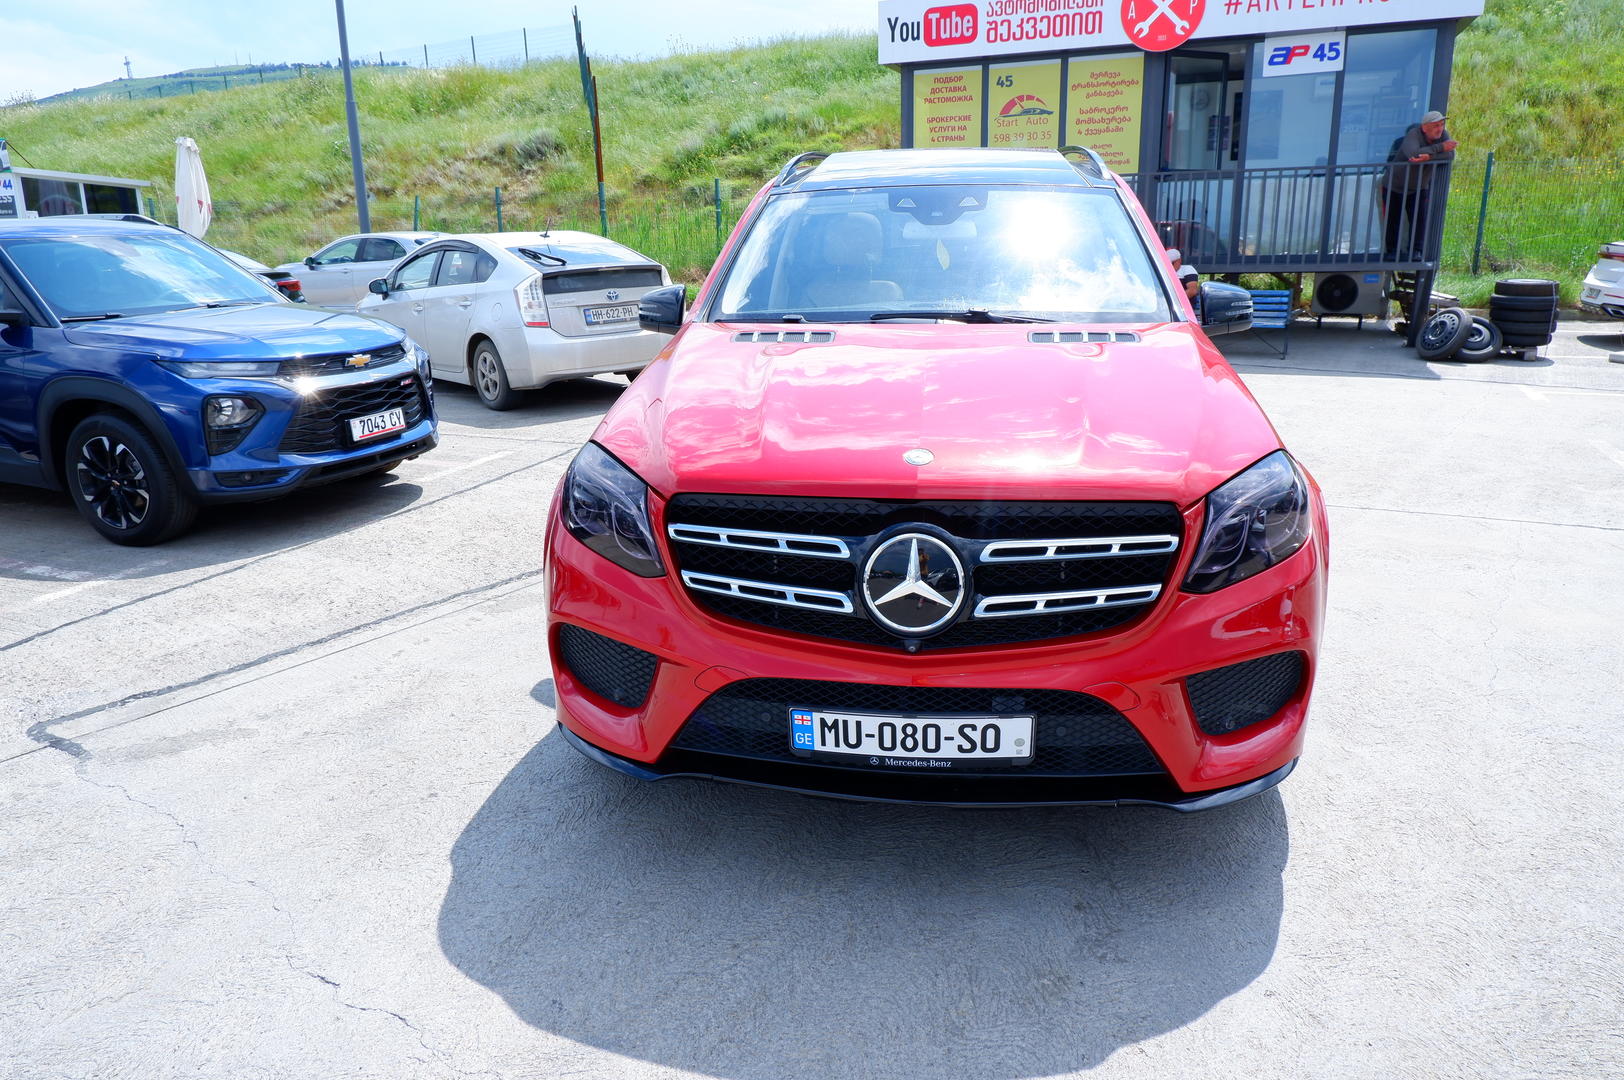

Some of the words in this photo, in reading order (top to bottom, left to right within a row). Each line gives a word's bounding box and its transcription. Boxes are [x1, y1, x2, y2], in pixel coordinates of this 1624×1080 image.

[1128, 0, 1136, 20] A
[1189, 0, 1198, 15] P
[887, 17, 921, 43] You
[928, 12, 974, 40] Tube
[986, 10, 1103, 43] შეკვეთით
[1312, 41, 1341, 62] 45
[933, 75, 964, 84] ПОДБОР
[996, 75, 1014, 88] 45
[930, 85, 967, 95] ДОСТАВКА
[923, 95, 974, 105] РАСТОМОЖКА
[926, 114, 972, 124] БРОКЕРСКИЕ
[996, 118, 1018, 128] Start
[1026, 116, 1049, 126] Auto
[929, 125, 956, 134] УСЛУГИ
[957, 124, 968, 132] НА
[937, 135, 966, 143] СТРАНЫ
[994, 133, 1010, 143] 598
[1027, 131, 1038, 141] 30
[1040, 130, 1052, 140] 35
[591, 308, 634, 321] HH-622-PH
[359, 415, 386, 434] 7043
[389, 411, 402, 427] CY
[795, 732, 813, 745] GE
[819, 716, 1001, 754] MU-080-SO
[884, 758, 952, 768] Mercedes-Benz
